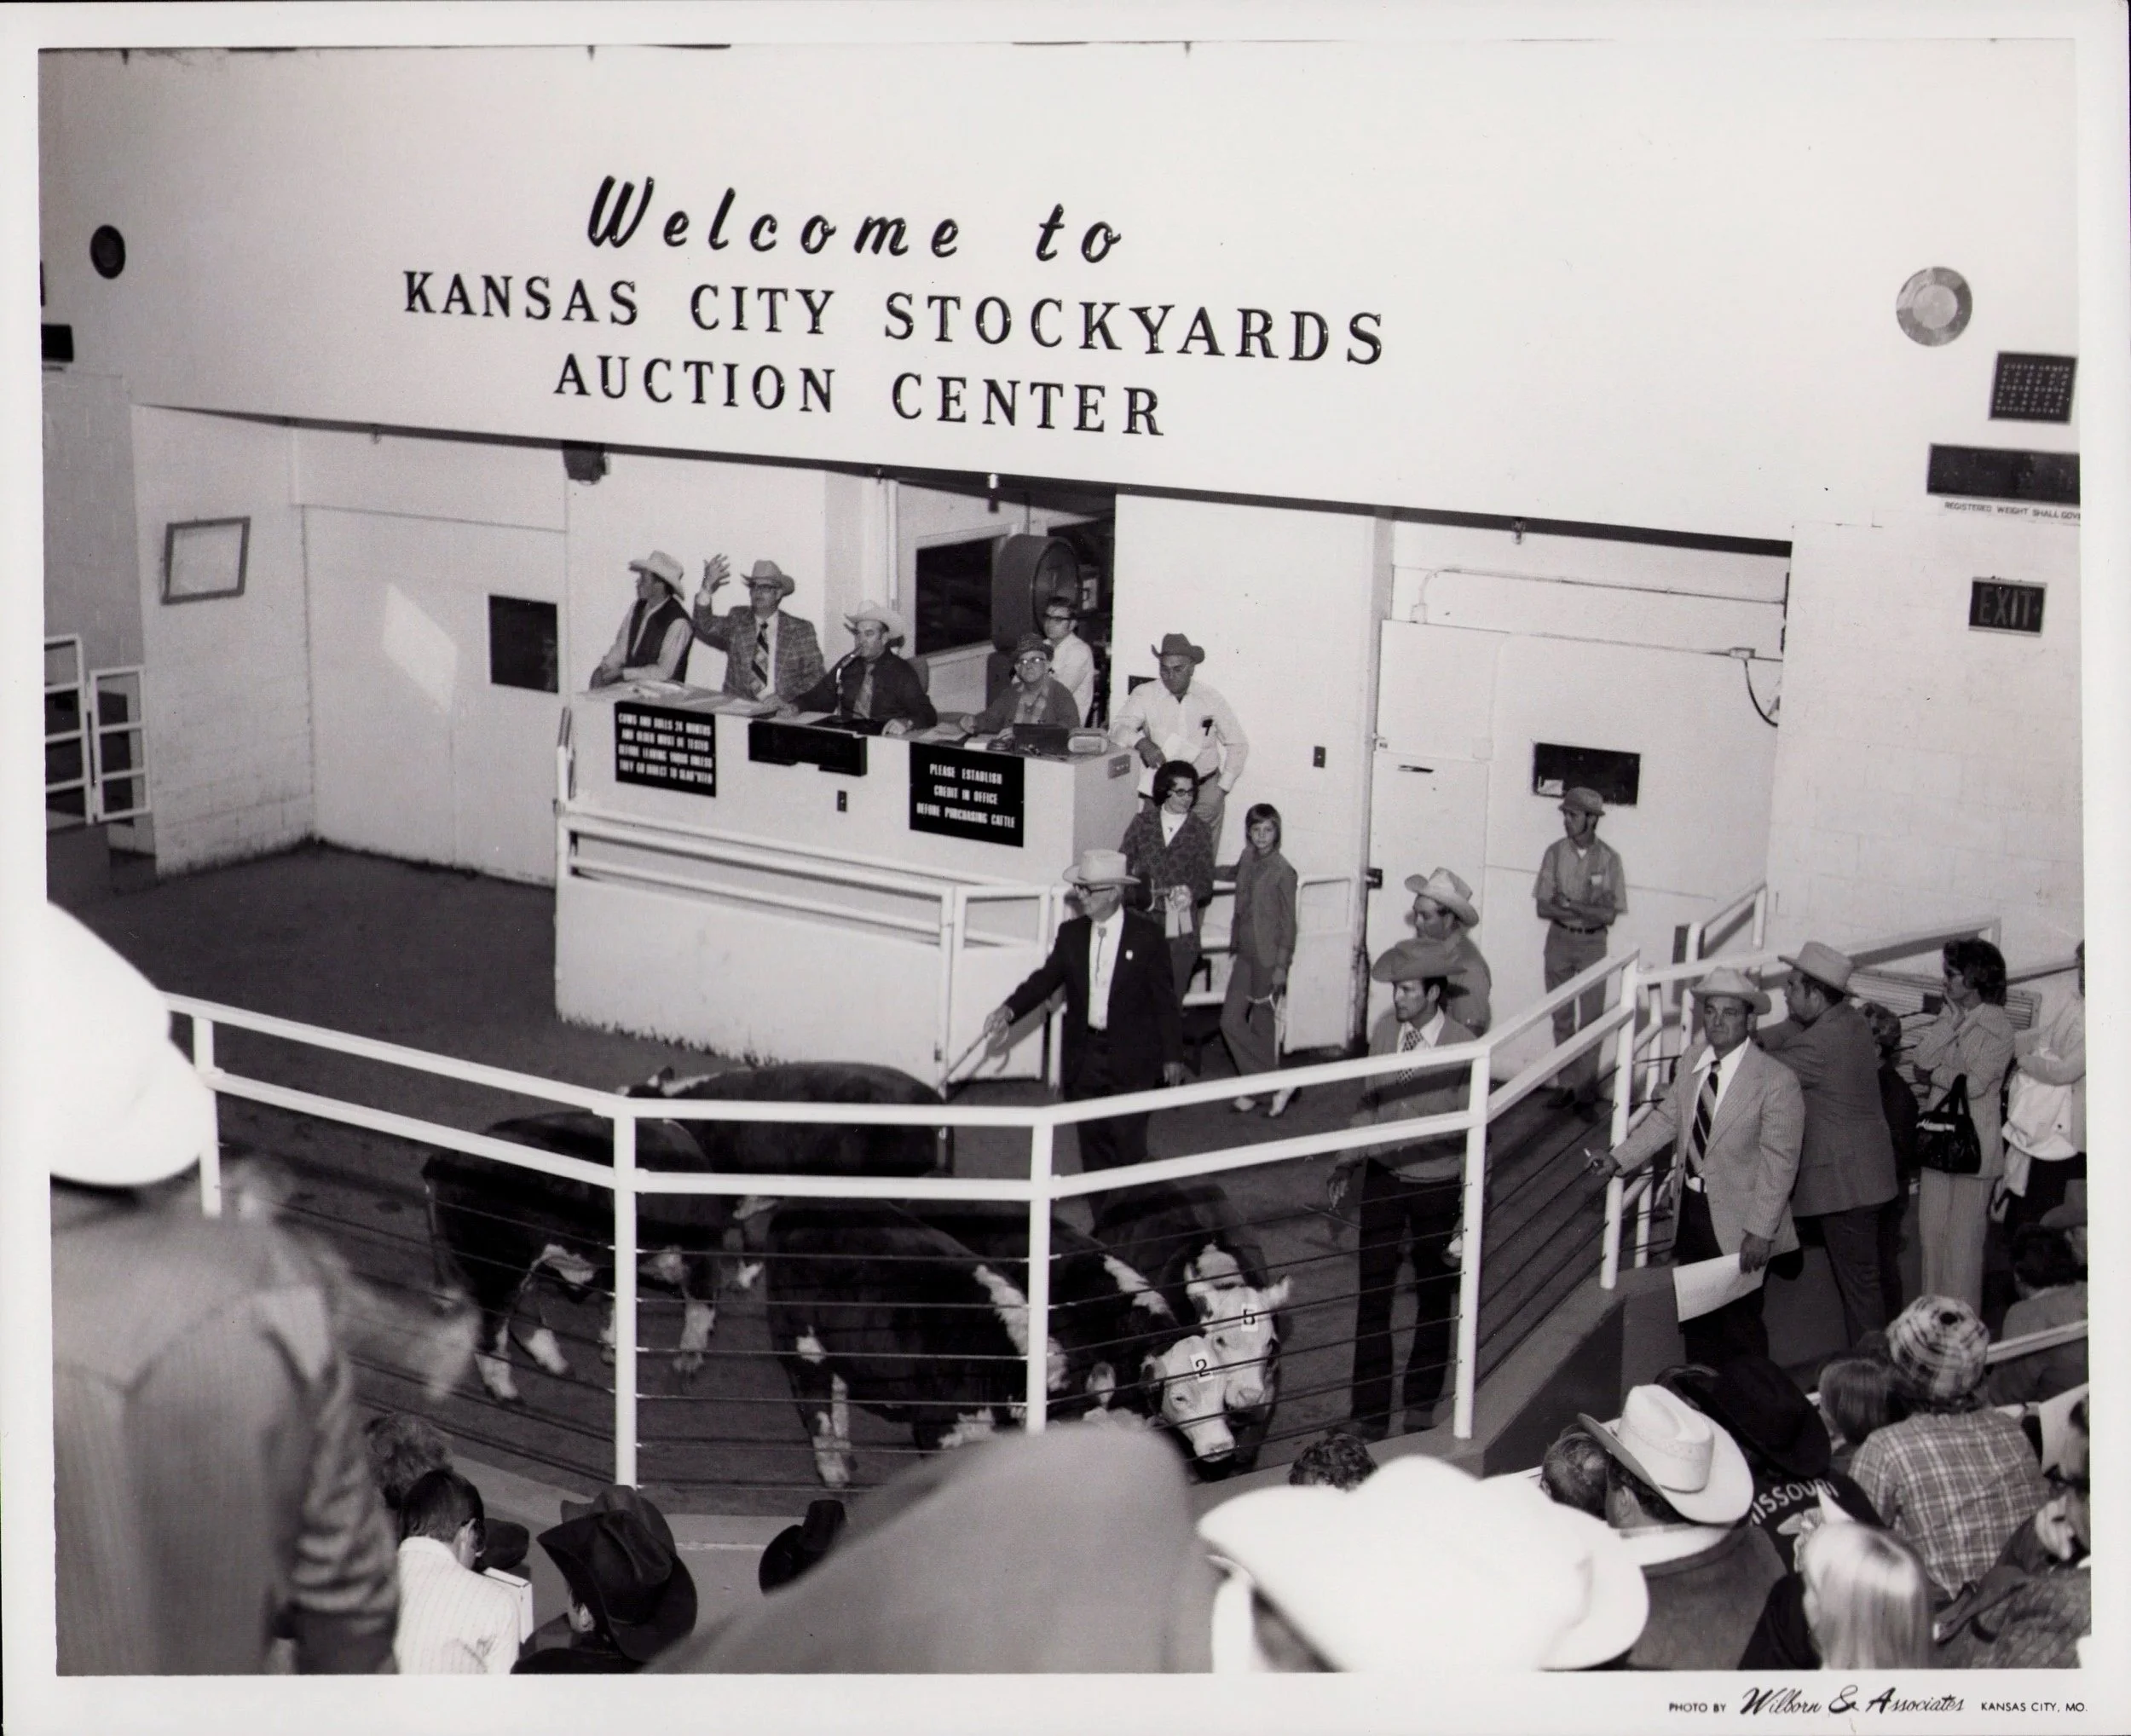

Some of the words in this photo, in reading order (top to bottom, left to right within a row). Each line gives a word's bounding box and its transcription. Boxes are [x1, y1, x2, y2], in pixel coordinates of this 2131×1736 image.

[588, 176, 958, 257] Welcome
[1037, 205, 1121, 262] to
[404, 271, 637, 325] KANSAS
[691, 285, 834, 334] CITY
[886, 292, 1381, 365] STOCKYARDS
[554, 354, 834, 412] AUCTION
[892, 373, 1164, 435] CENTER
[1944, 501, 1992, 512] REGISTERED
[1996, 505, 2029, 515] WEIGHT
[2032, 509, 2059, 518] SHALL
[1978, 586, 2036, 627] EXIT
[929, 764, 956, 777] PLEASE
[962, 768, 1002, 785] ESTABLISH
[933, 785, 958, 799] CREDIT
[962, 789, 970, 801] IN
[973, 791, 998, 805] OFFICE
[916, 803, 940, 816] BEFORE
[944, 807, 988, 824] PURCHASING
[991, 814, 1015, 828] CATTLE
[1243, 1308, 1256, 1325] 5
[1195, 1358, 1210, 1377] 2
